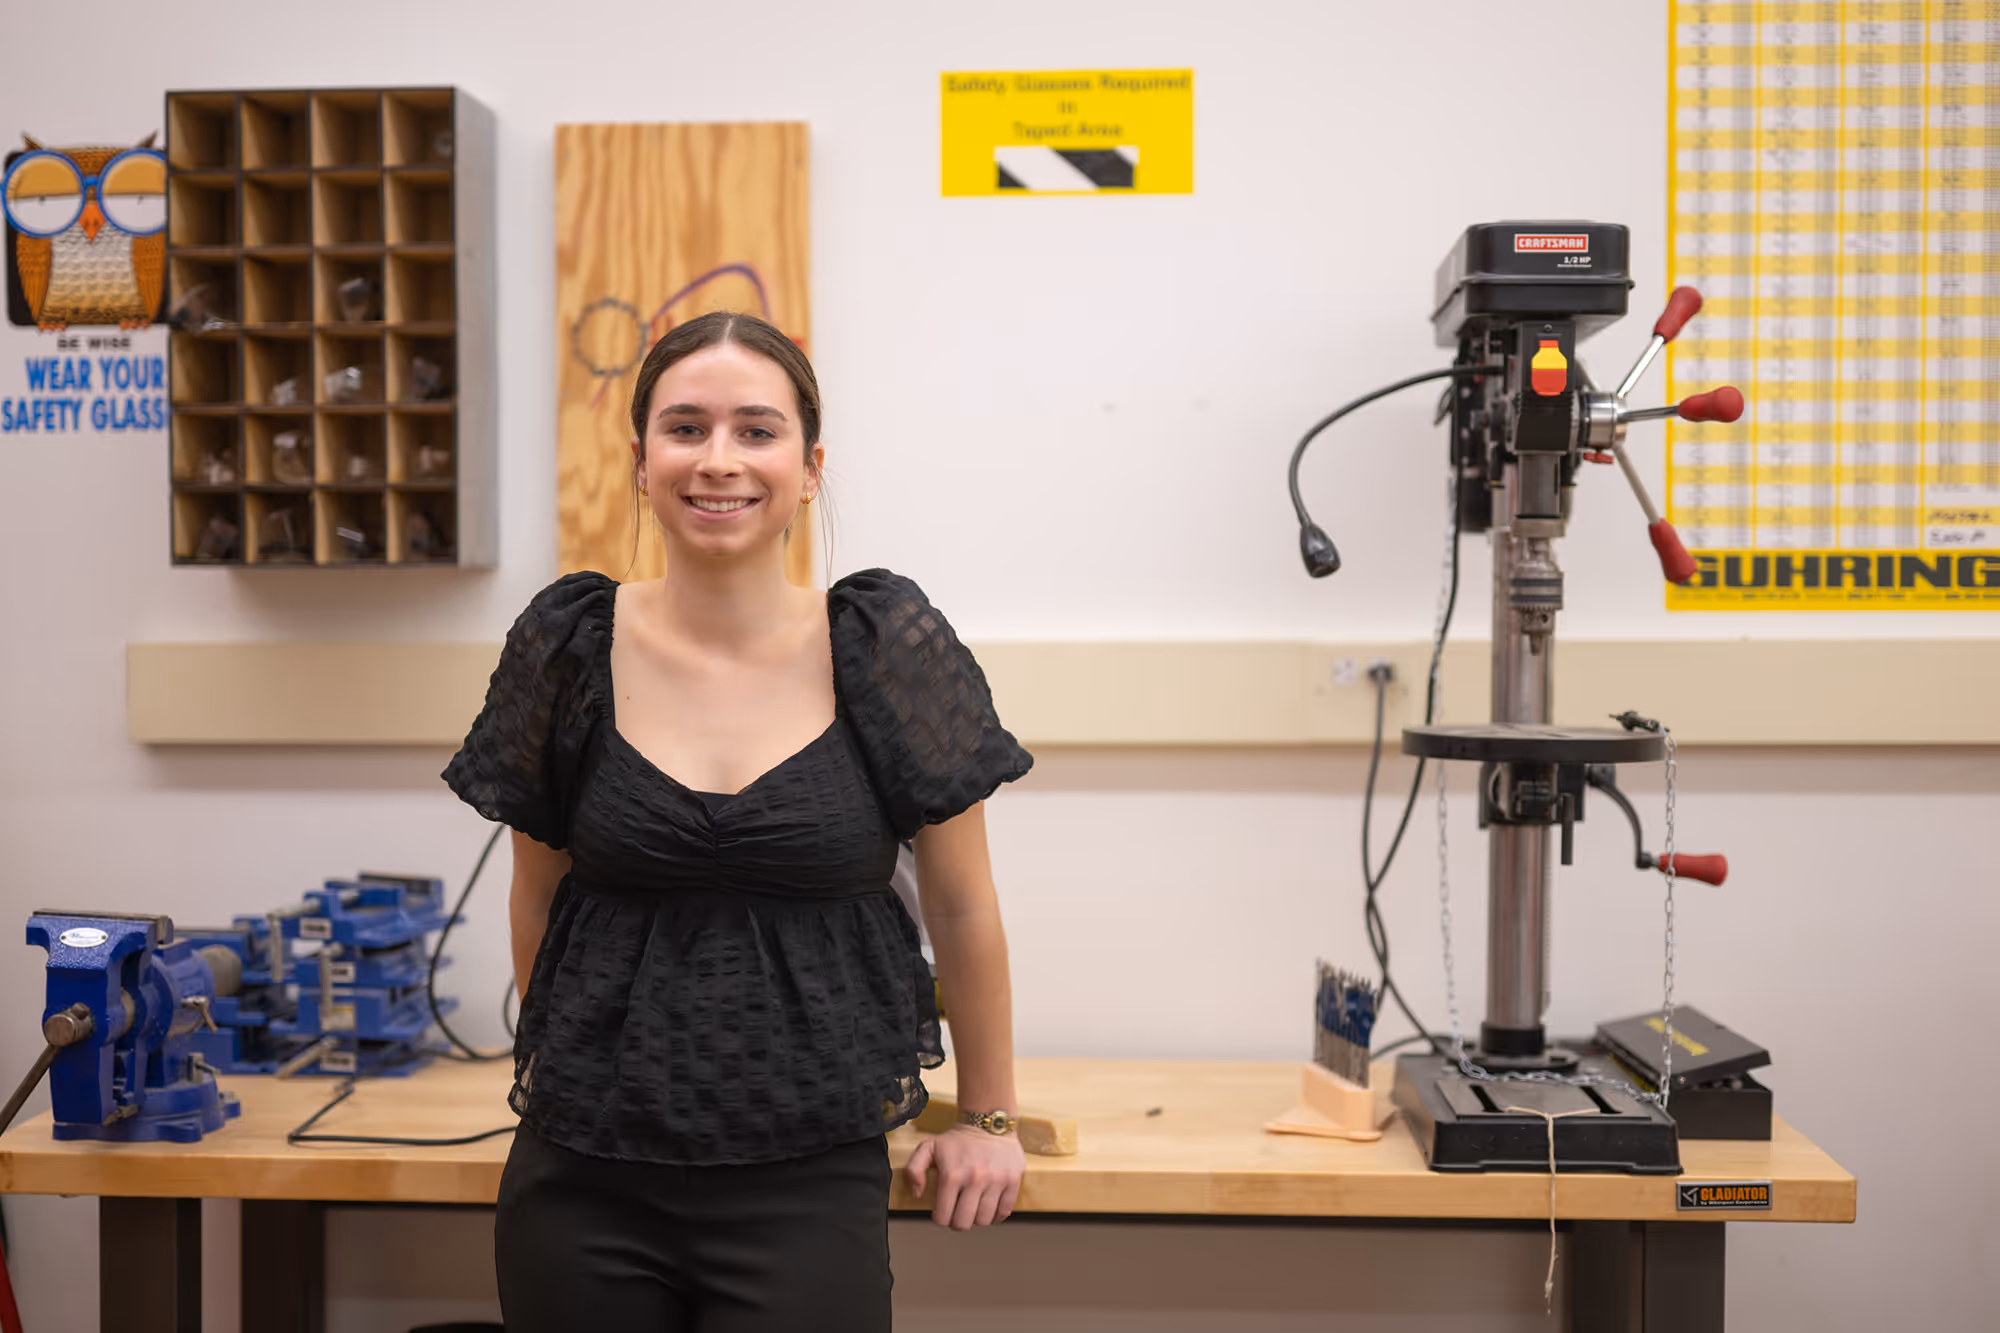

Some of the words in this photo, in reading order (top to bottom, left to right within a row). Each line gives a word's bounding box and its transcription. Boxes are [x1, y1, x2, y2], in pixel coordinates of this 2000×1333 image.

[947, 76, 1006, 94] Safety
[1015, 74, 1091, 92] Glasses
[1099, 72, 1191, 93] Required
[1518, 238, 1584, 248] CRAFTSMAN
[57, 336, 80, 350] BE
[88, 336, 131, 350] WISE
[25, 356, 91, 391] WEAR
[99, 356, 164, 391] YOUR
[1, 397, 82, 432] SAFETY
[91, 397, 170, 432] GLASS
[1701, 1187, 1767, 1200] GLADIATOR
